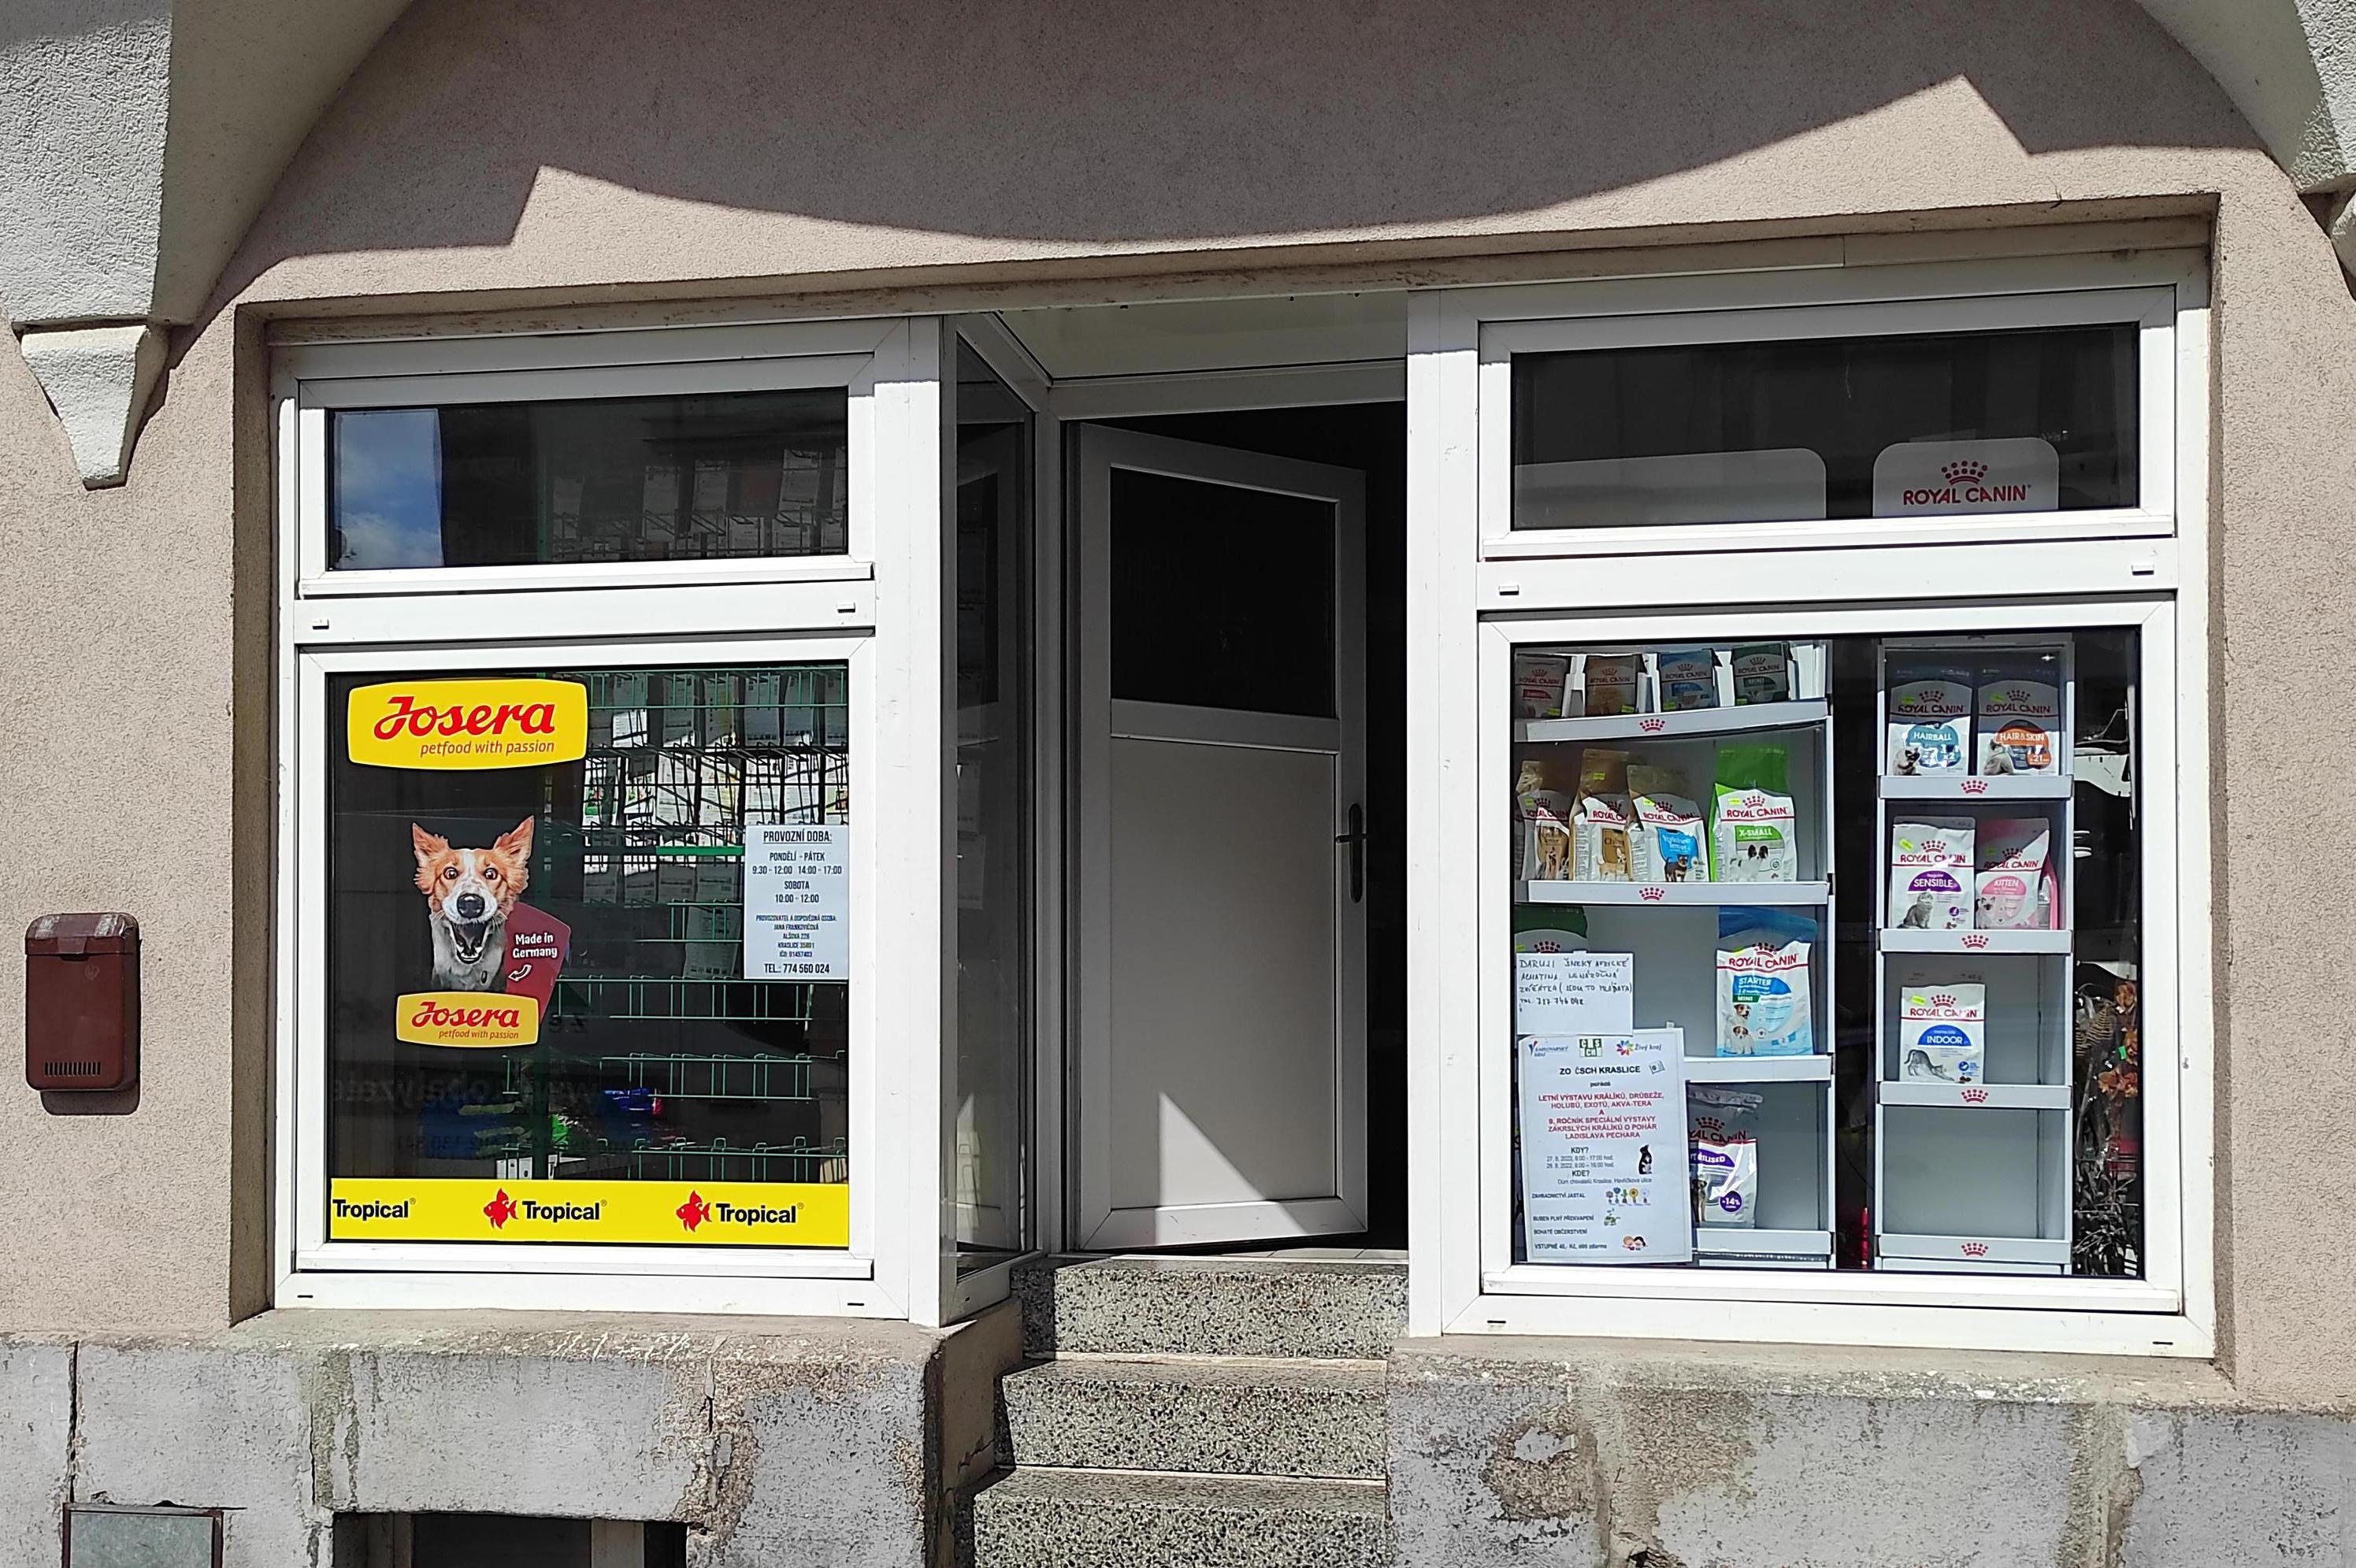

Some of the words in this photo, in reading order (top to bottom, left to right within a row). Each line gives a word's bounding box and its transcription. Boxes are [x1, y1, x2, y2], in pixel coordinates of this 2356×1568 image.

[1903, 488, 1961, 505] ROYAL
[1965, 485, 2026, 502] CANIN
[1931, 705, 1964, 714] CANIN
[1987, 704, 2017, 713] ROYAL
[2020, 705, 2050, 714] CANIN
[374, 696, 555, 740] Josera
[1913, 732, 1953, 740] HAIRBALL
[421, 740, 472, 757] petfood
[475, 740, 503, 754] with
[506, 740, 555, 756] passion
[1593, 810, 1615, 820] ROYAL
[1643, 812, 1667, 821] ROYAL
[1757, 807, 1786, 816] CANIN
[763, 828, 804, 842] PROVOZNÍ
[807, 831, 832, 841] DOBA:
[1739, 828, 1772, 836] X-SMALL
[770, 851, 796, 861] PONDĚLÍ
[803, 851, 825, 861] PÁTEK
[1901, 854, 1931, 863] ROYAL
[2012, 860, 2039, 869] CANIN
[798, 866, 816, 874] 14:00
[824, 866, 842, 874] 17:00
[1913, 879, 1953, 888] SENSIBLE
[515, 933, 542, 945] Made
[513, 948, 558, 958] Germany
[1729, 958, 1762, 967] ROYAL
[1765, 954, 1797, 968] CANIN
[783, 964, 797, 973] 774
[799, 964, 813, 973] 560
[815, 964, 829, 973] 024
[412, 1002, 519, 1028] Josera
[1910, 1008, 1941, 1017] ROYAL
[439, 1029, 469, 1039] petfood
[490, 1031, 518, 1040] passion
[1927, 1036, 1962, 1044] INDOOR
[1549, 1124, 1590, 1132] ZÁKRSLÝCH
[1592, 1122, 1623, 1131] KRÁLÍKŮ
